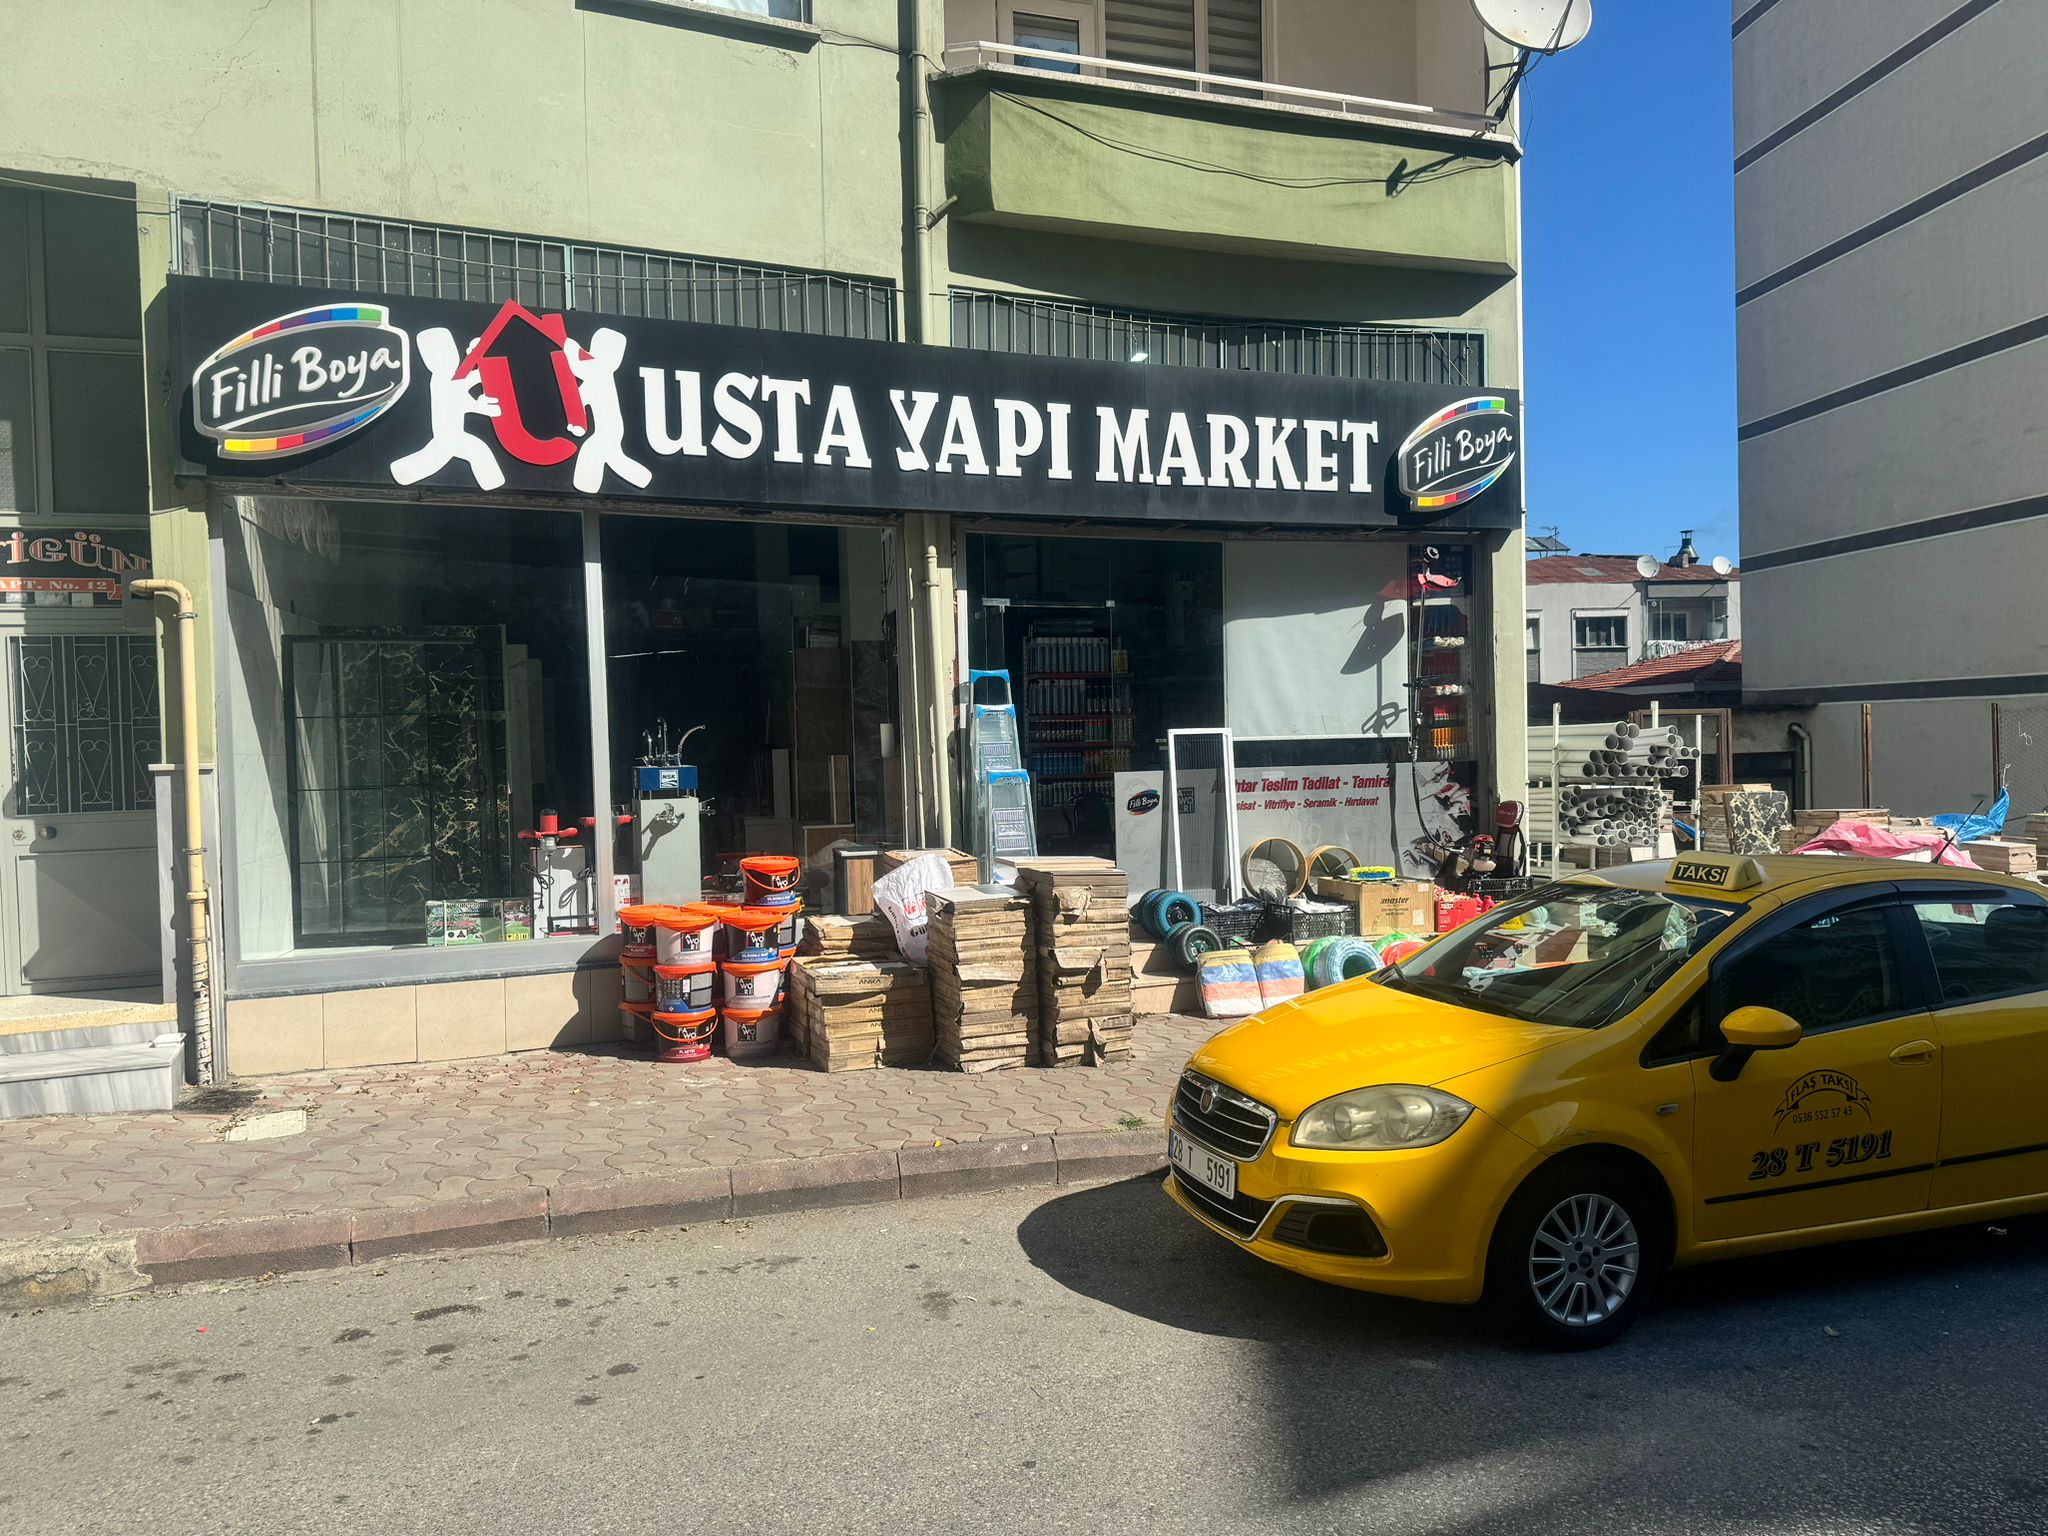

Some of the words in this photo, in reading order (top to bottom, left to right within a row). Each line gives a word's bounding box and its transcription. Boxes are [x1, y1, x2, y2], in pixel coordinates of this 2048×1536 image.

[210, 353, 284, 419] Filli
[290, 346, 400, 399] Boya
[638, 366, 872, 469] USTA
[889, 388, 1073, 480] YAPI
[1095, 406, 1379, 493] MARKET
[1412, 436, 1451, 485] Filli
[1455, 426, 1513, 464] Boya
[0, 530, 150, 574] İGÜN
[50, 580, 80, 589] No.
[87, 580, 107, 589] 12
[1261, 777, 1298, 792] Teslim
[1302, 776, 1340, 791] Tadilat
[1264, 799, 1296, 810] Vitrifiye
[1303, 797, 1337, 809] Seramik
[1790, 1075, 1817, 1102] FLAŞ
[1792, 1111, 1813, 1124] 0536
[1815, 1109, 1829, 1121] 552
[1831, 1107, 1841, 1118] 57
[1843, 1106, 1853, 1117] 43
[1173, 1135, 1183, 1163] 28
[1188, 1145, 1194, 1170] T
[1206, 1157, 1230, 1193] 5191
[1748, 1148, 1788, 1181] 28
[1795, 1141, 1820, 1173] T
[1825, 1129, 1893, 1168] 5191
